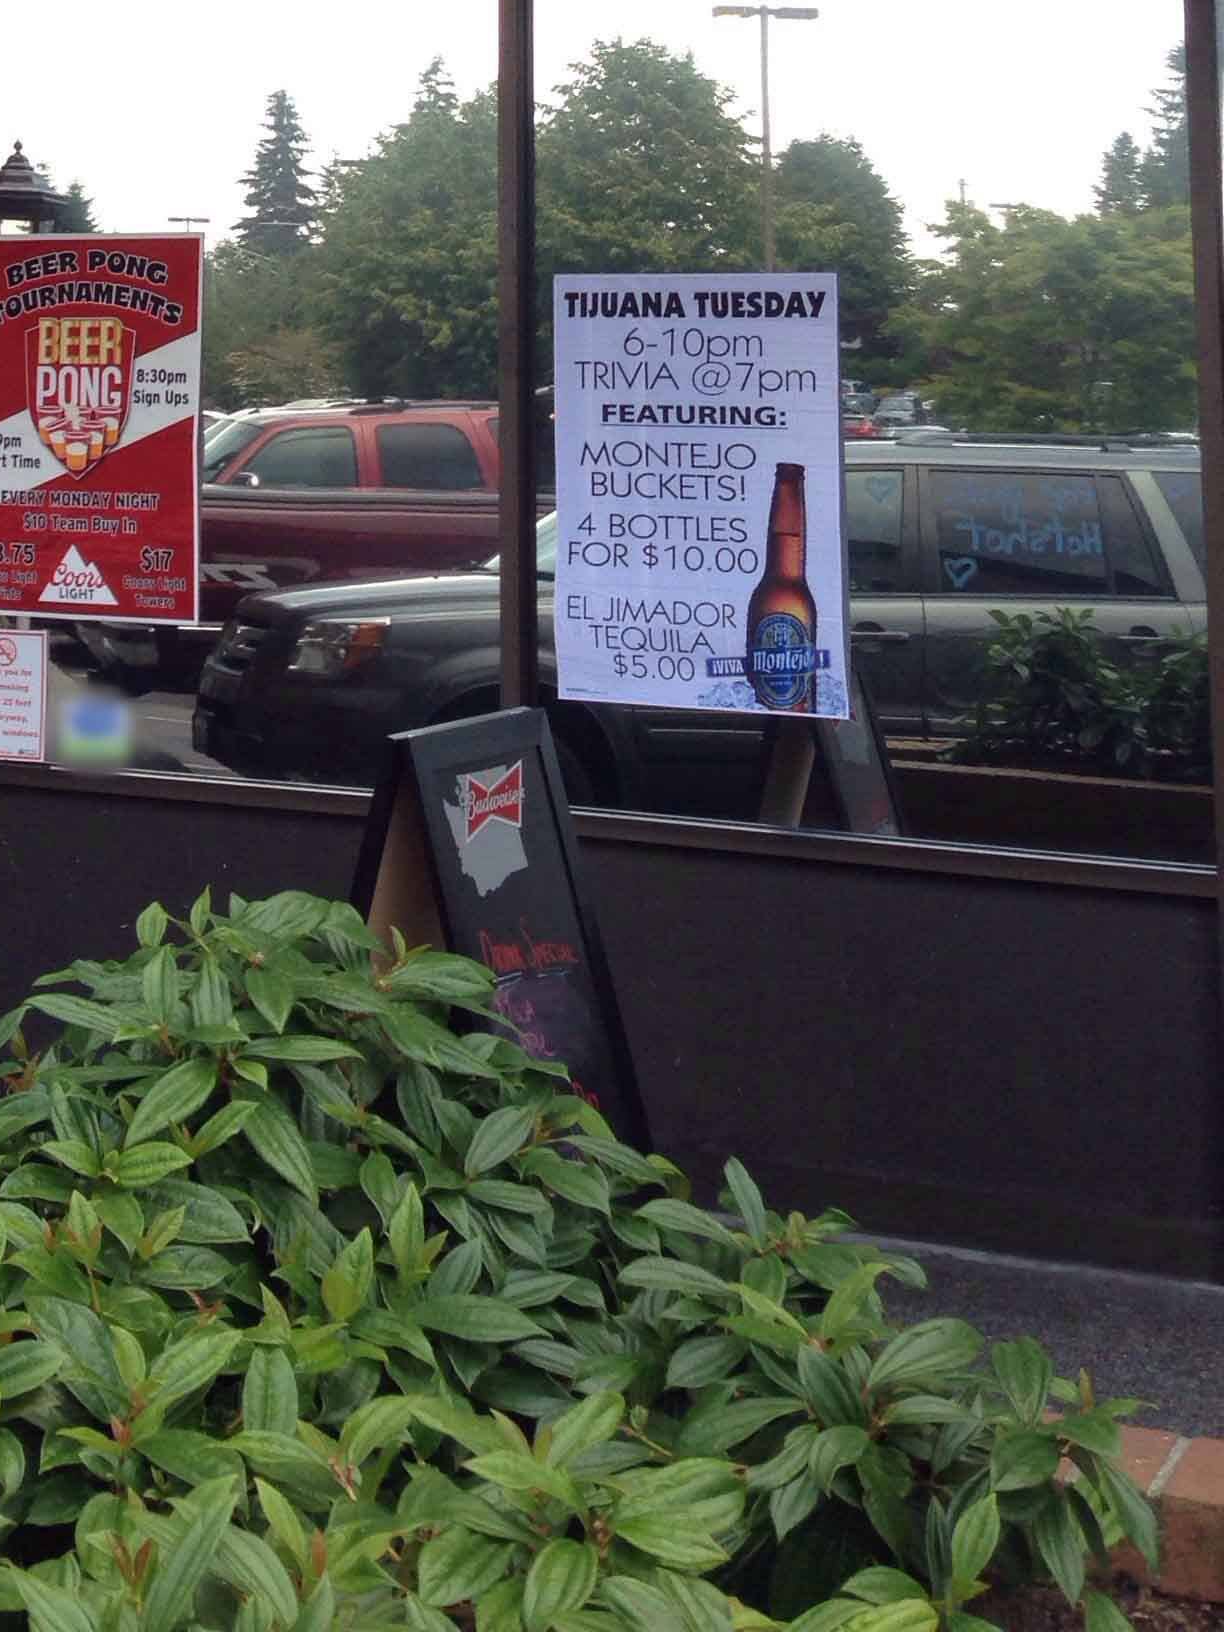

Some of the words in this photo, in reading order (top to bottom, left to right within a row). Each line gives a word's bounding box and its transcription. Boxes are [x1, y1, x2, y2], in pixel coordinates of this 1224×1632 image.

[5, 249, 80, 289] BEER
[87, 249, 168, 286] PONG
[564, 291, 685, 318] TIJUANA
[694, 291, 826, 319] TUESDAY
[38, 318, 123, 365] BEER
[623, 327, 764, 364] 6-10pm
[36, 365, 122, 409] PONG
[136, 369, 188, 385] 8:30pm
[574, 361, 679, 391] TRIVIA
[133, 390, 161, 406] Sign
[165, 391, 189, 406] Ups
[601, 404, 787, 426] FEATURING:
[11, 455, 41, 469] Time
[580, 441, 757, 470] MONTEJO
[1, 490, 44, 508] EVERY
[49, 491, 111, 510] MONDAY
[116, 493, 160, 511] NIGHT
[591, 471, 746, 502] BUCKETS!
[23, 513, 46, 530] $10
[52, 515, 88, 532] Team
[92, 516, 119, 536] Buy
[122, 517, 137, 534] In
[577, 513, 596, 536] 4
[609, 513, 749, 543] BOTTLES
[139, 545, 174, 573] $17
[568, 542, 629, 568] FOR
[642, 544, 759, 574] $10.00
[51, 564, 105, 587] Coors
[58, 588, 95, 601] LIGHT
[567, 595, 593, 622] EL
[602, 598, 736, 628] JIMADOR
[588, 624, 716, 655] TEQUILA
[614, 653, 695, 681] $5.00
